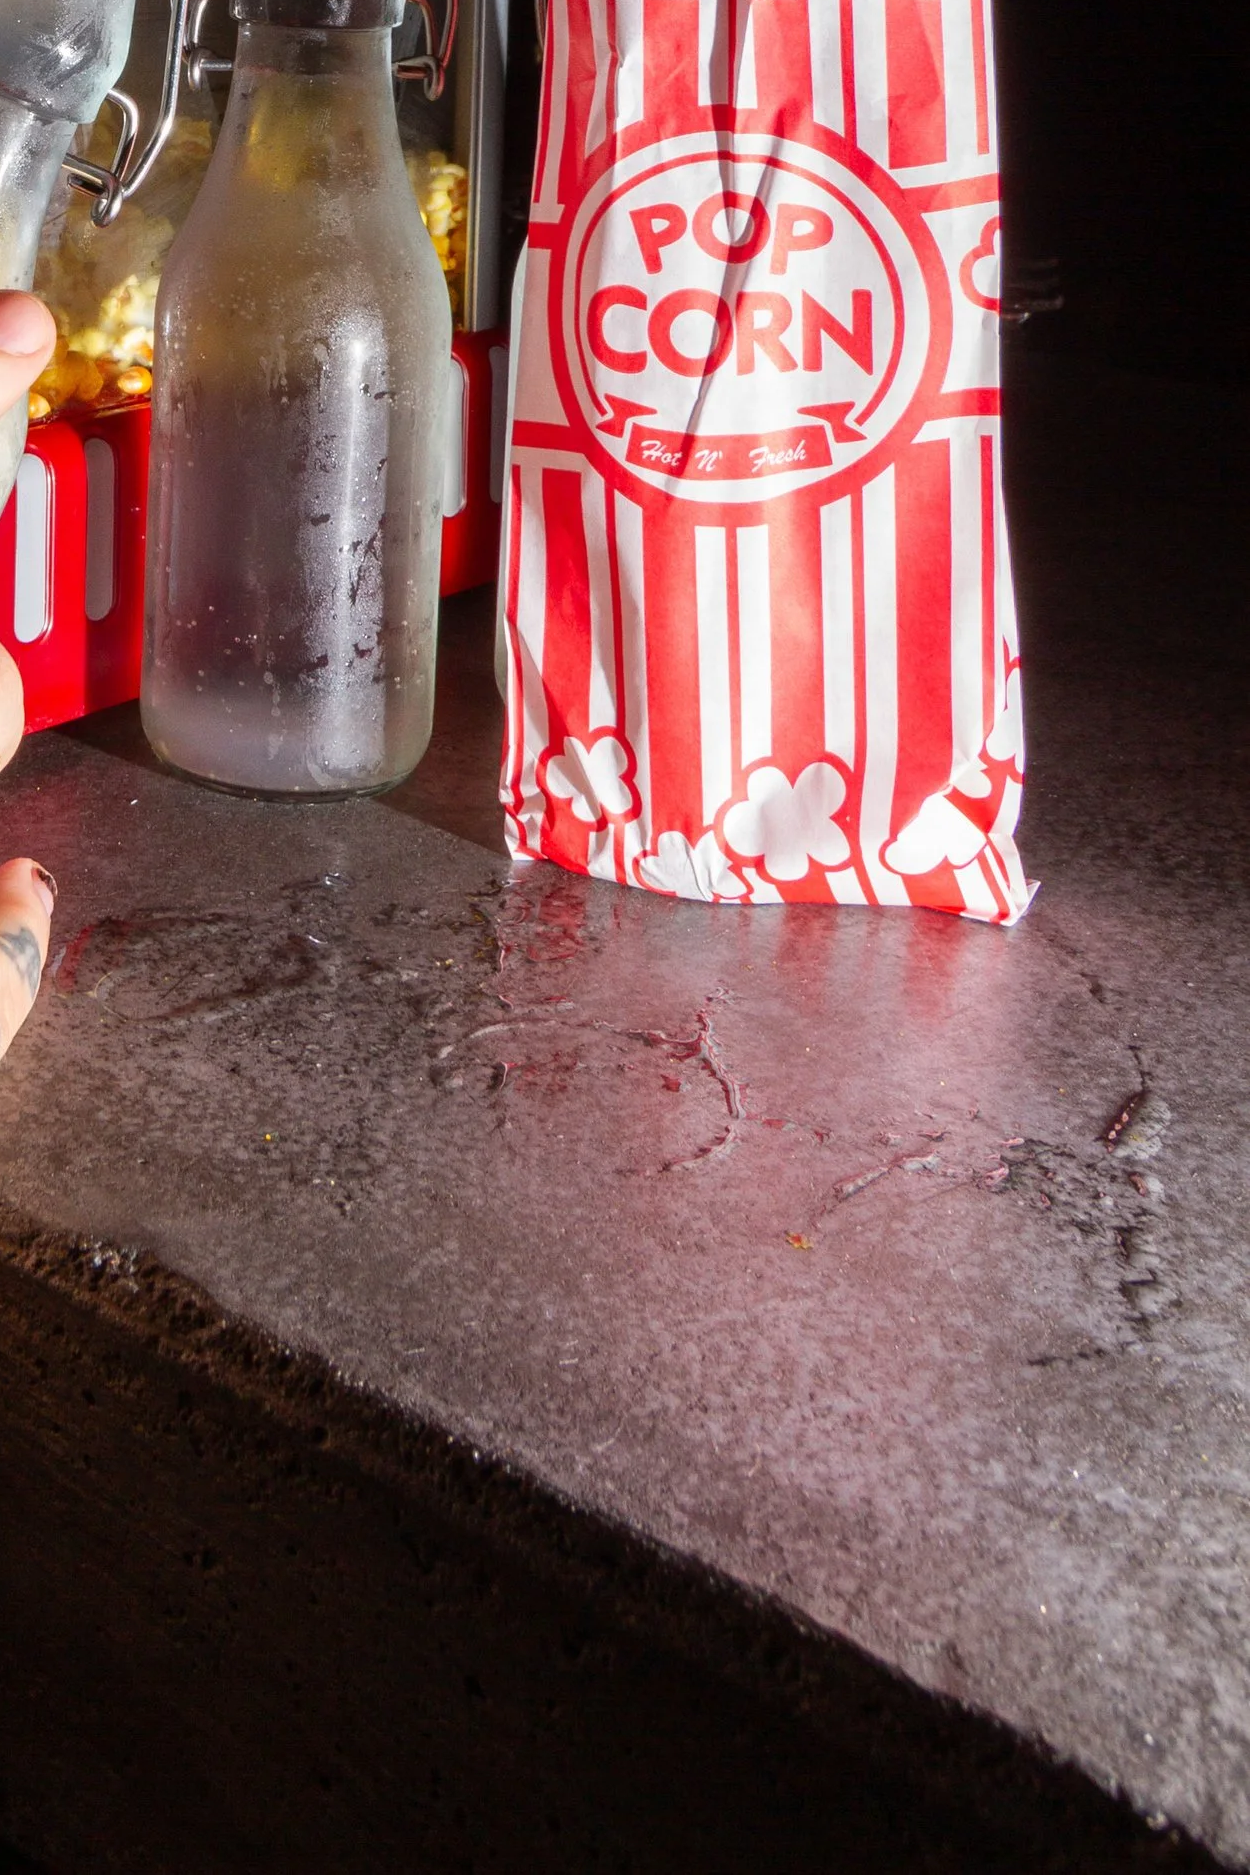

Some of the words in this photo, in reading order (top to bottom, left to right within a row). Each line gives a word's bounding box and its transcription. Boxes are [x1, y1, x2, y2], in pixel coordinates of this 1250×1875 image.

[630, 190, 834, 275] POP
[587, 283, 874, 377] CORN
[640, 439, 684, 467] Hot
[748, 439, 807, 473] Fresh
